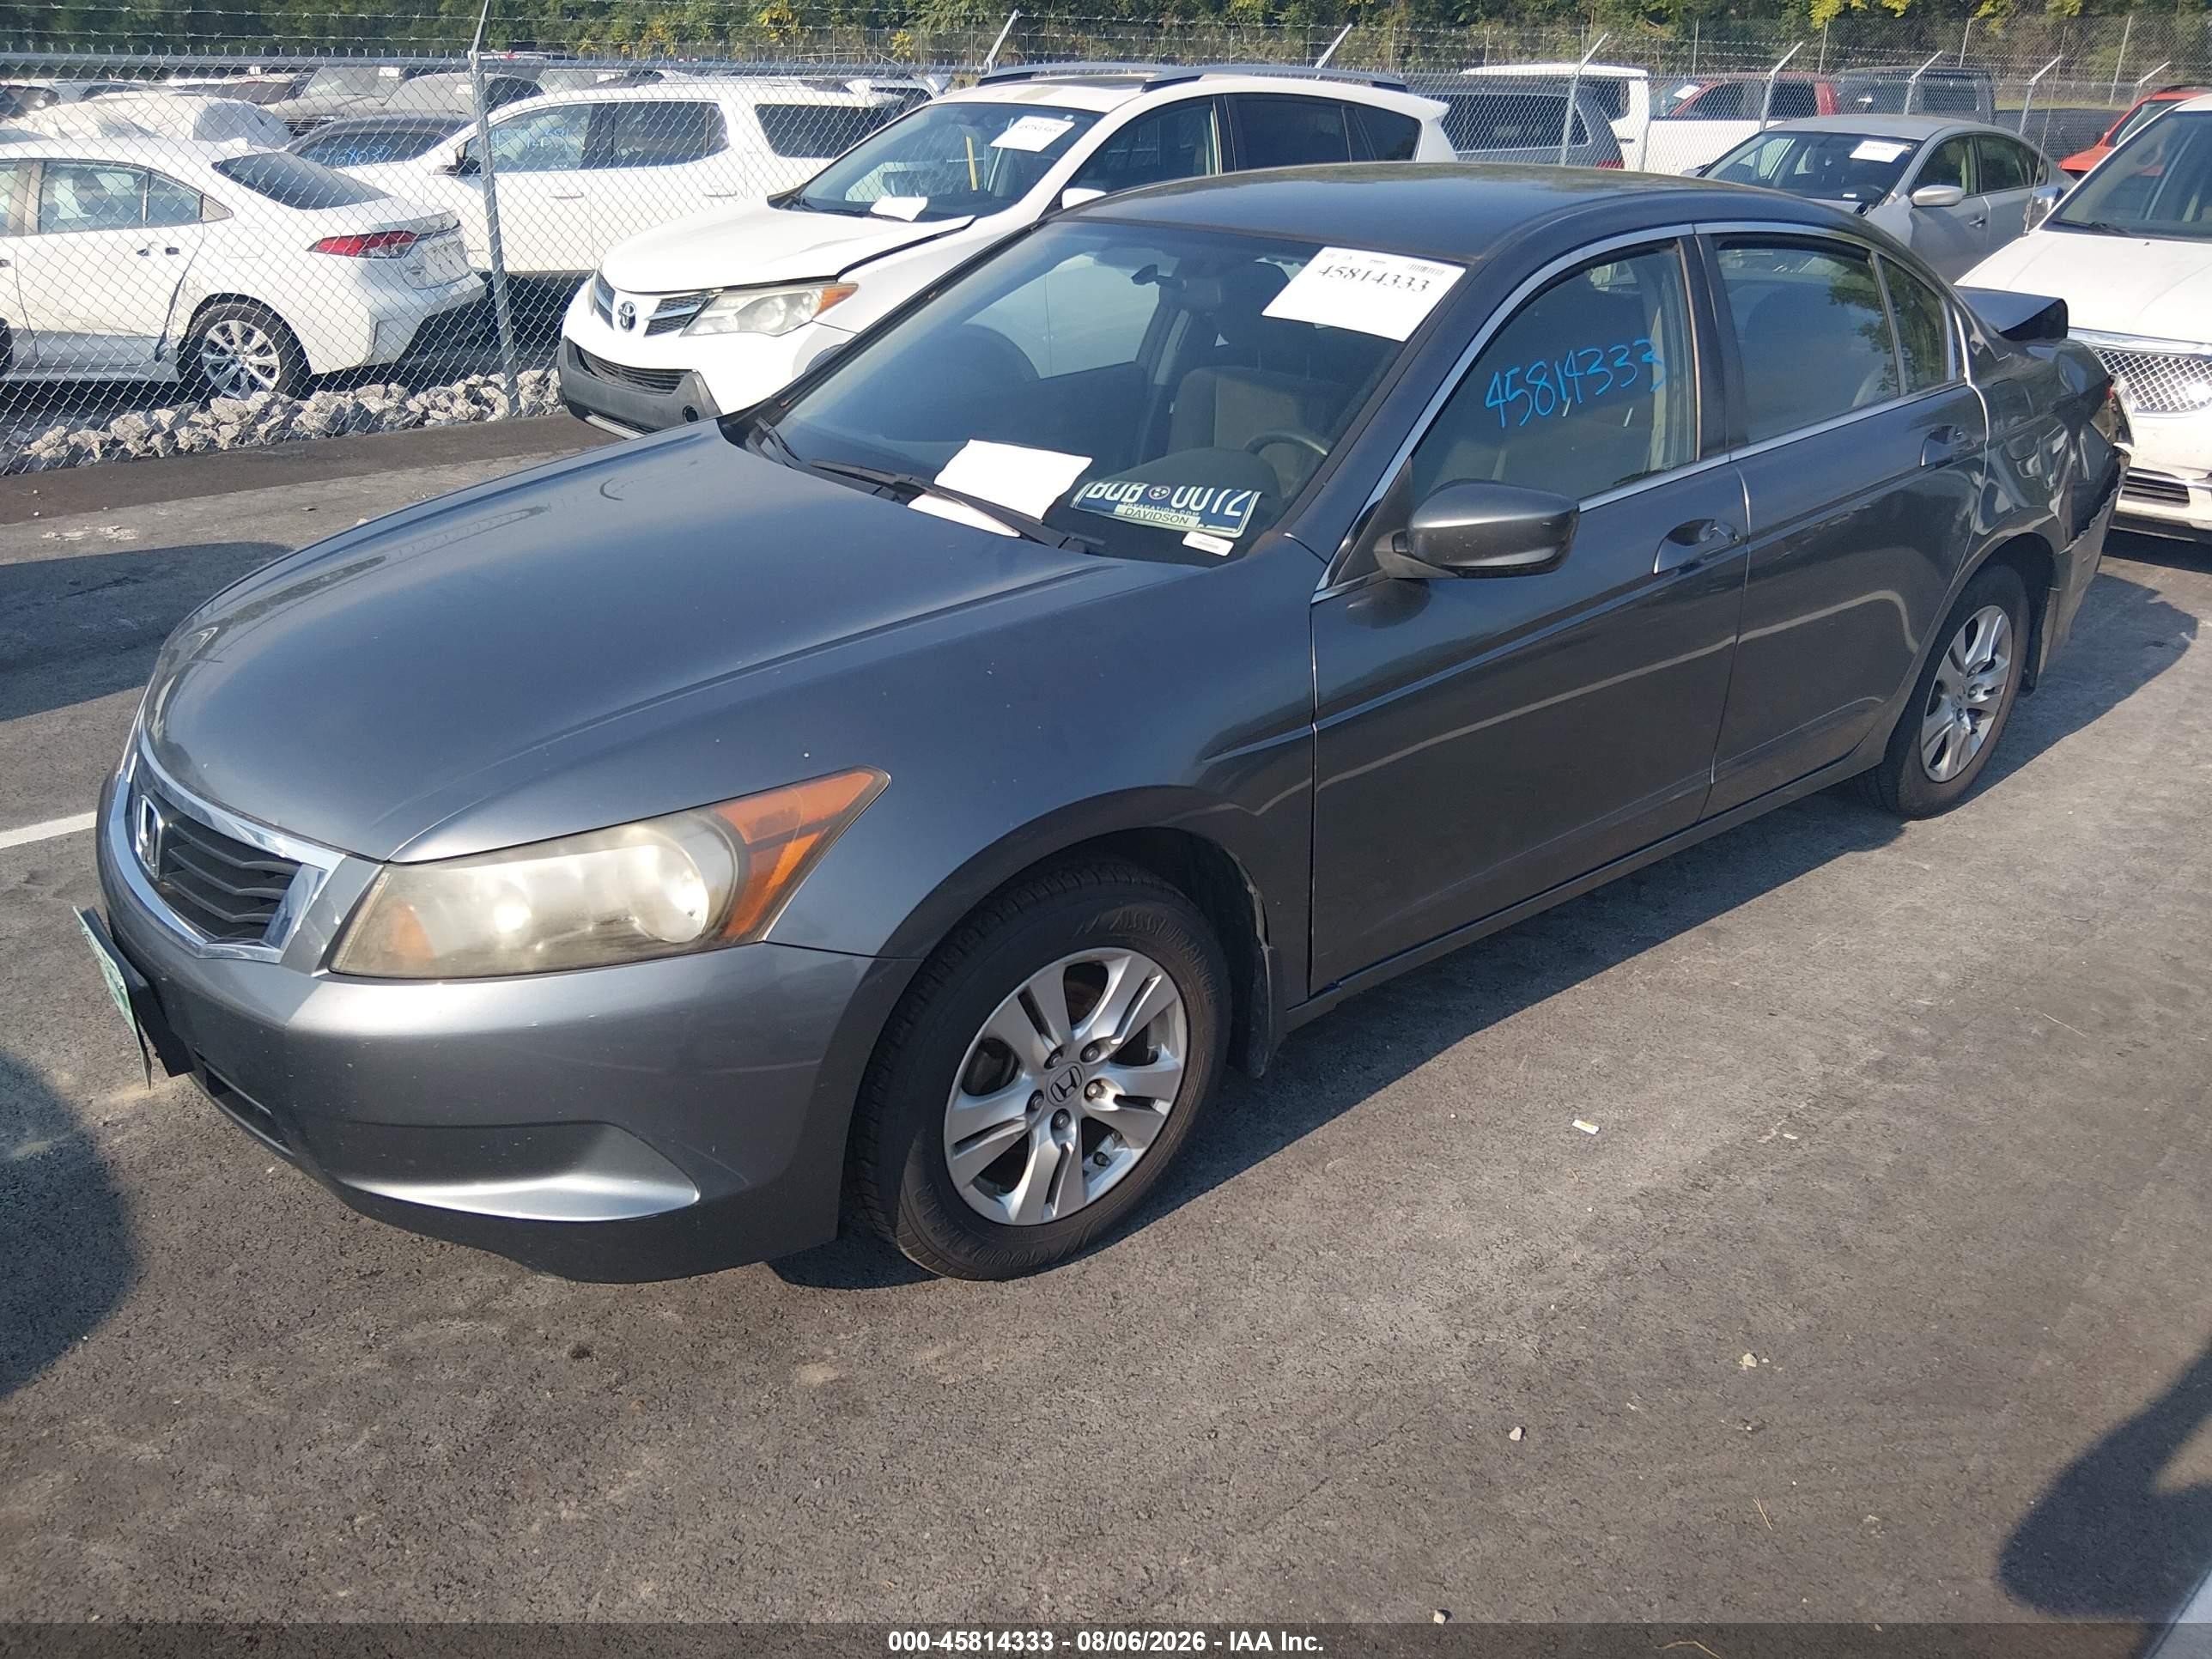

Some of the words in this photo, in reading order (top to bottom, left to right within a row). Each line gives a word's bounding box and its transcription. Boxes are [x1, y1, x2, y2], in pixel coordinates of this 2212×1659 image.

[1319, 264, 1431, 293] 45814333
[1485, 338, 1667, 428] 45814333
[1125, 507, 1189, 526] DAVIDSON
